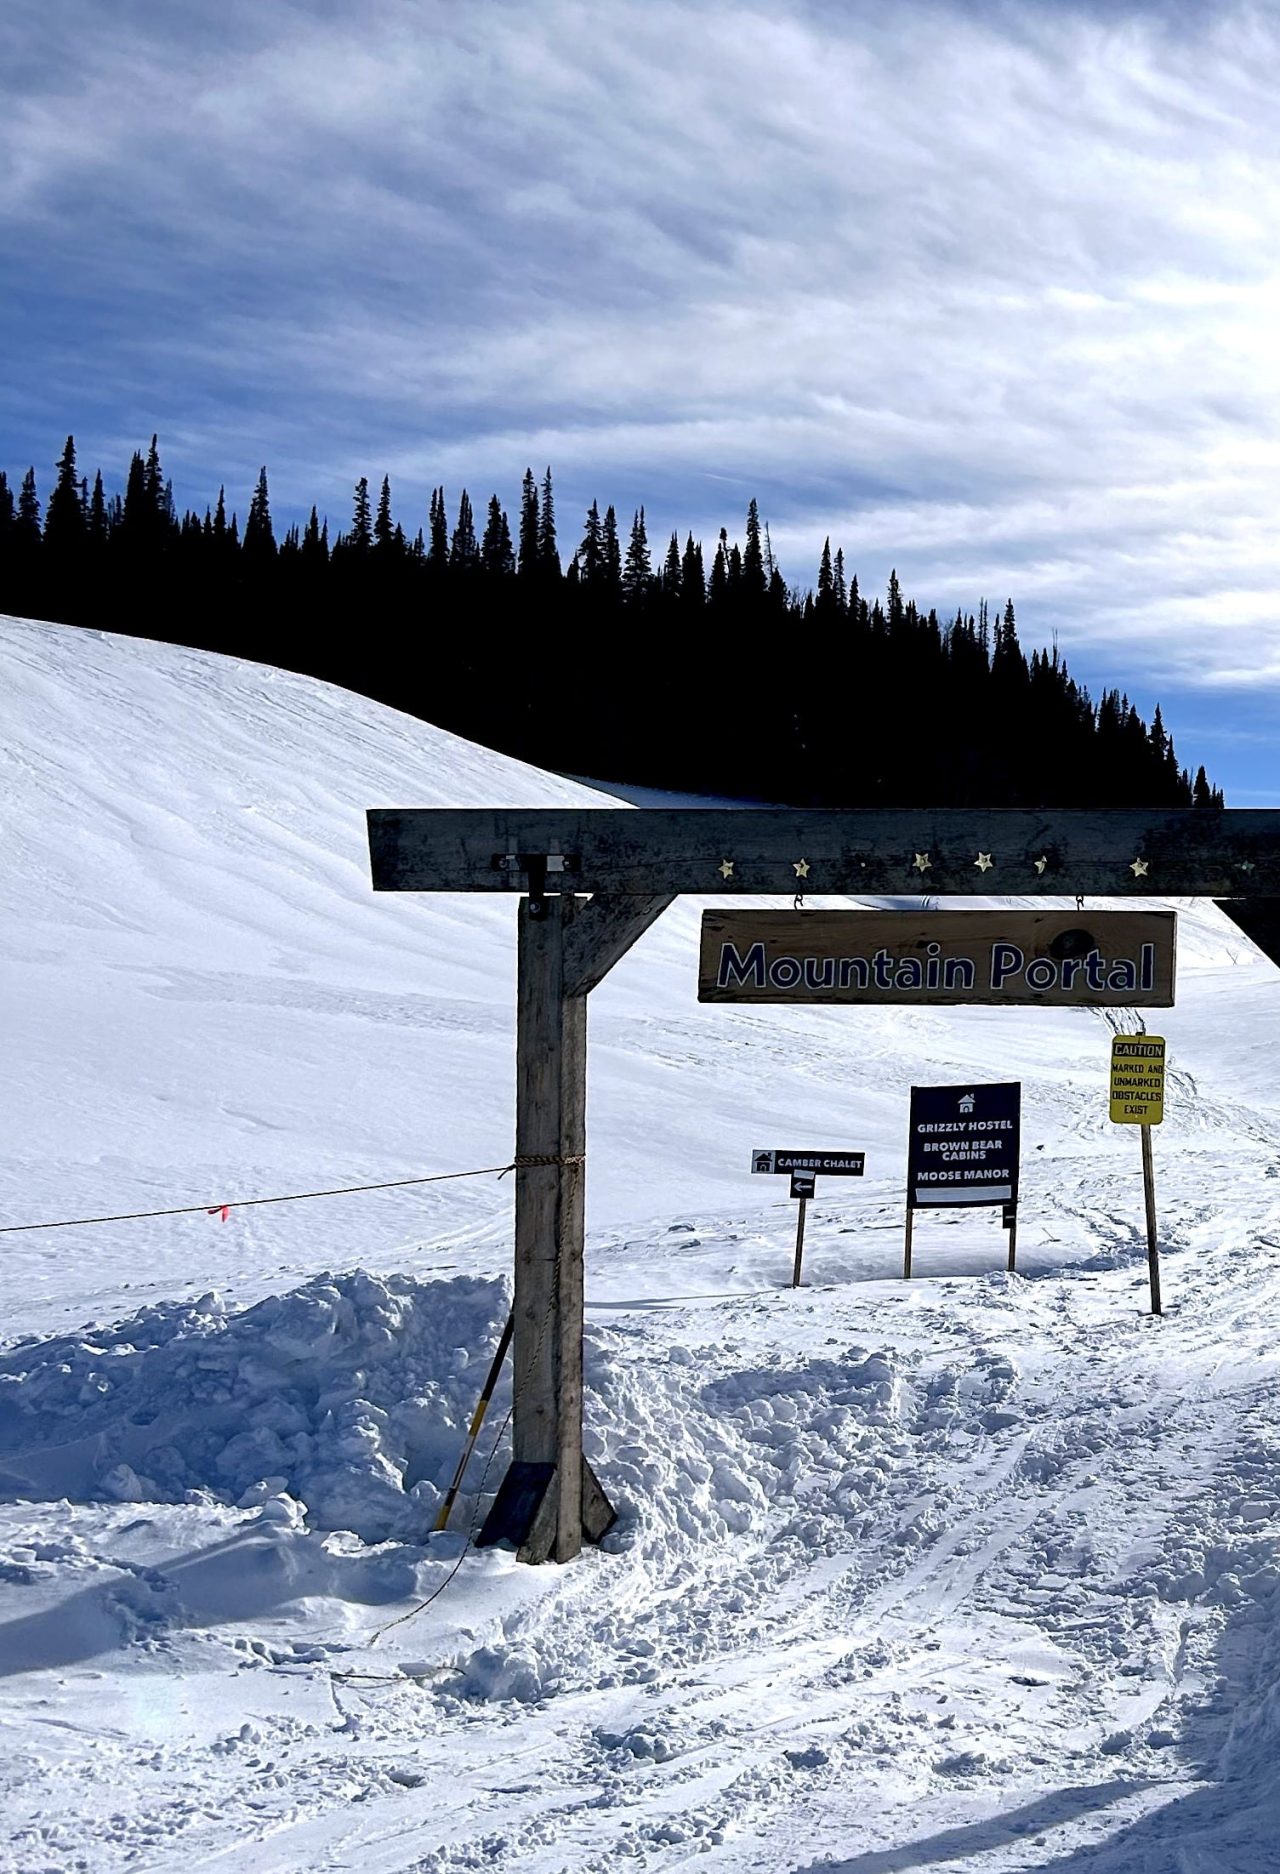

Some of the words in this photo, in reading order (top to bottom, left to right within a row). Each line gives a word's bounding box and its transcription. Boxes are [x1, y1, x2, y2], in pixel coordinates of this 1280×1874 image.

[716, 942, 975, 990] Mountain
[990, 942, 1155, 992] Portal
[1115, 1044, 1163, 1056] CAUTION
[1112, 1063, 1144, 1073] MARKED
[1147, 1064, 1164, 1073] AND
[1114, 1077, 1161, 1088] UNMARKED
[1112, 1090, 1162, 1102] OBSTACLES
[1124, 1104, 1148, 1114] EXIST
[917, 1122, 966, 1133] GRIZZLY
[968, 1120, 1013, 1131] HOSTEL
[923, 1141, 969, 1152] BROWN
[971, 1140, 1002, 1150] BEAR
[942, 1150, 986, 1161] CABINS
[777, 1158, 821, 1168] CAMBER
[823, 1159, 862, 1169] CHALET
[917, 1170, 961, 1181] MOOSE
[963, 1168, 1010, 1180] MANOR
